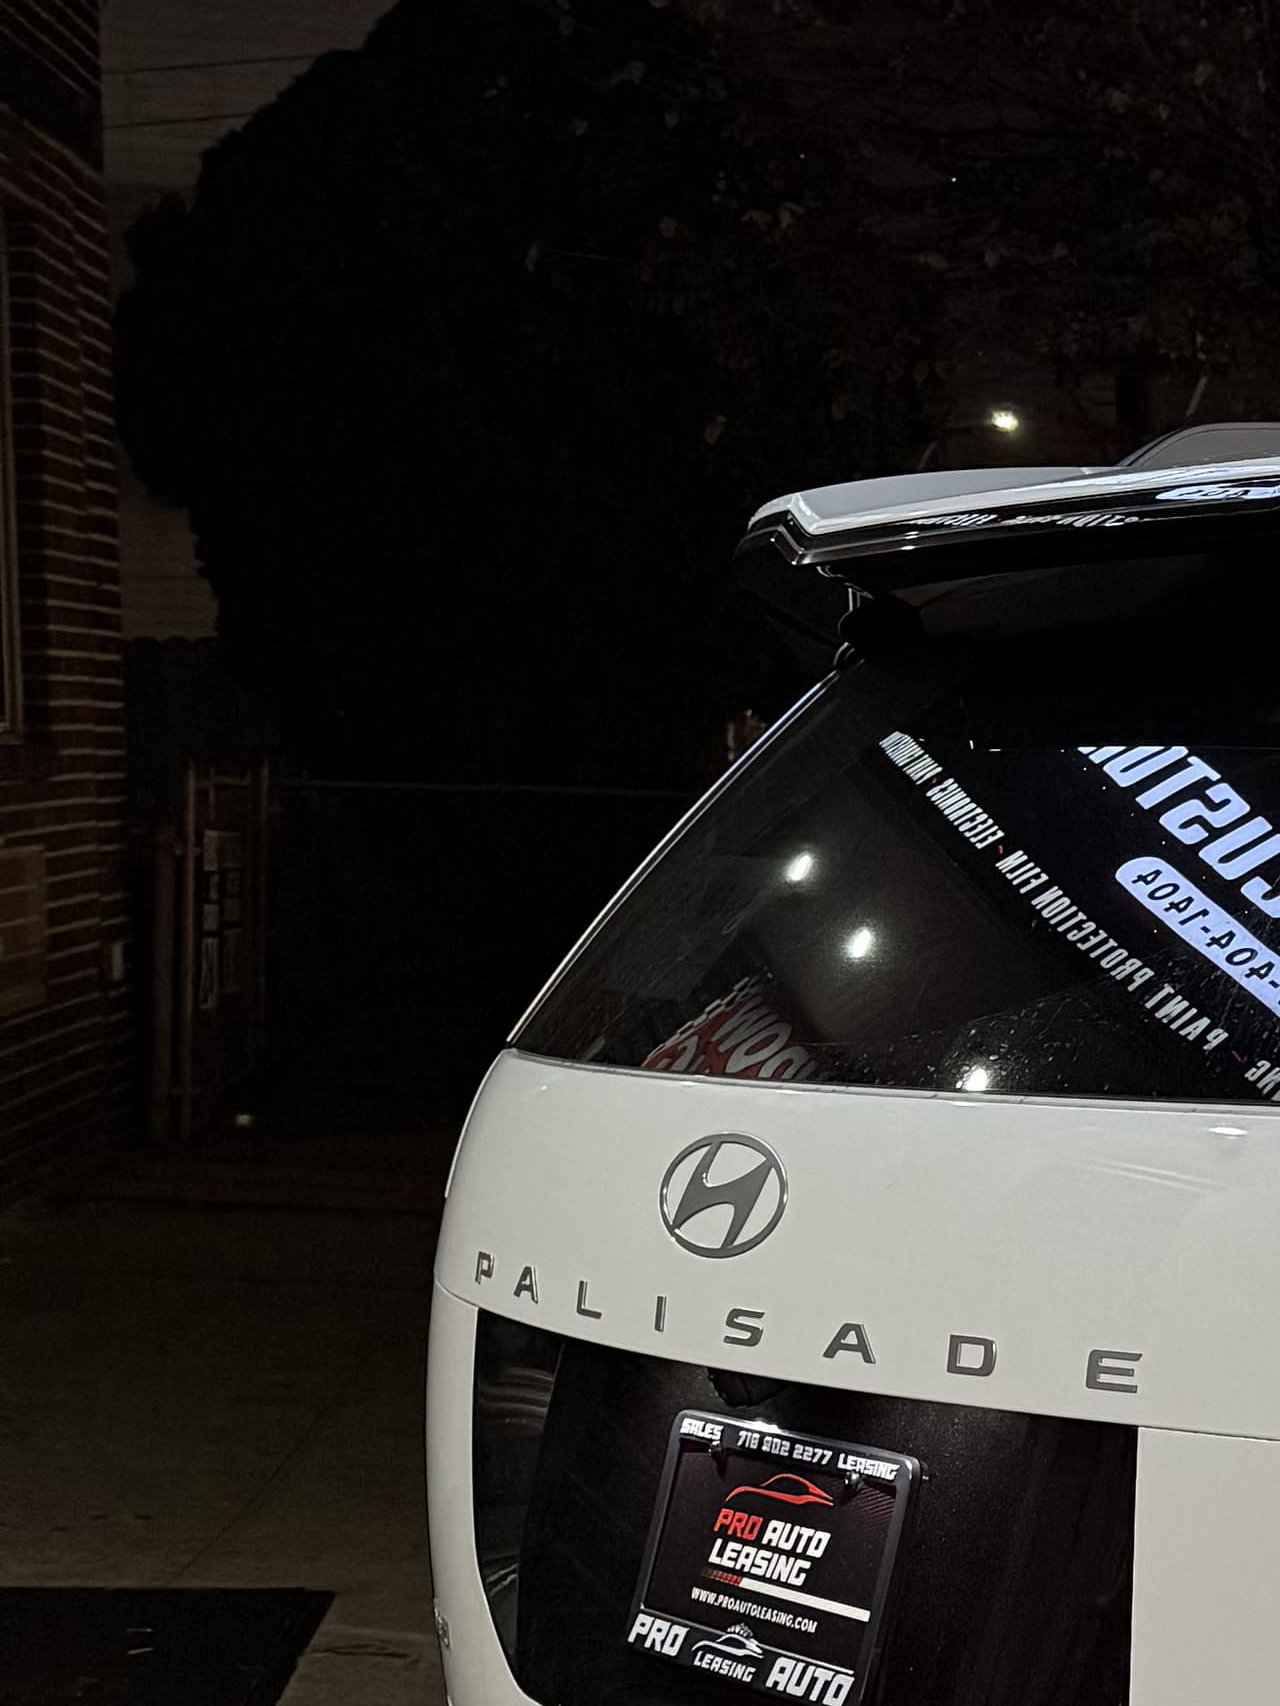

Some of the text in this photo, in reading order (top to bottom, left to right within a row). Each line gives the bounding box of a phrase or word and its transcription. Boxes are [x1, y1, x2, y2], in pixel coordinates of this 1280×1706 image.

[474, 1251, 1144, 1395] PALISADE
[679, 1417, 723, 1440] SALES
[736, 1430, 760, 1449] 718
[792, 1443, 833, 1465] 2277
[837, 1453, 900, 1480] LEASING
[713, 1508, 831, 1558] PRO AUTO
[708, 1538, 811, 1587] LEASING
[690, 1586, 818, 1633] WWW.PROAUTOLEASING.COM
[627, 1612, 690, 1657] PRO
[692, 1650, 757, 1683] LEASING
